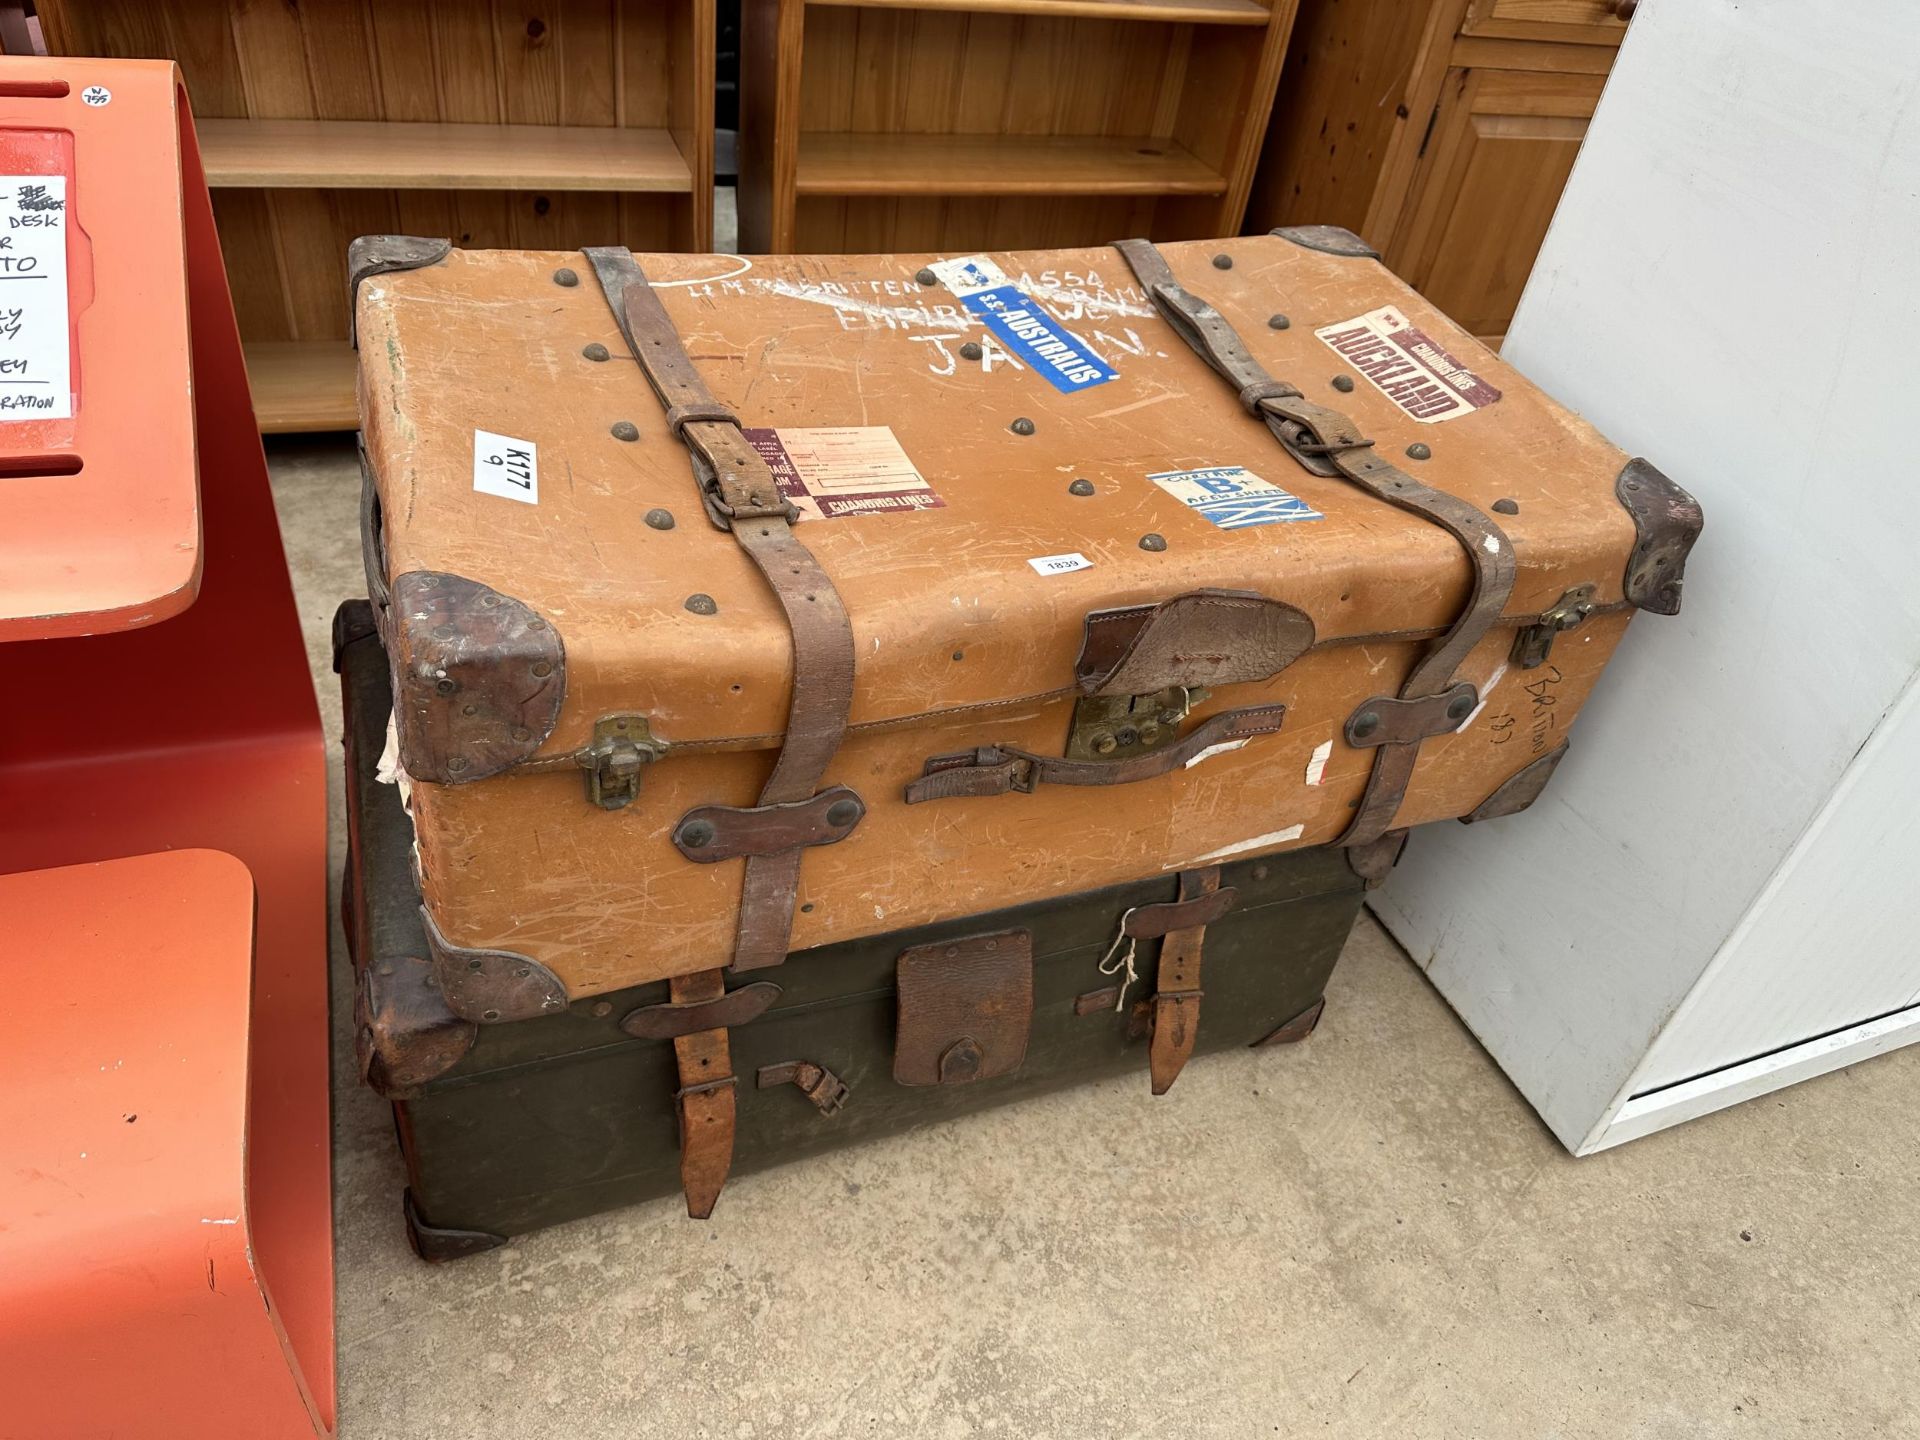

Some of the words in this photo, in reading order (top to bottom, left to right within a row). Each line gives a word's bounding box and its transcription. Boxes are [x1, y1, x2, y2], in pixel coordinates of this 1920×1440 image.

[9, 214, 58, 228] DESK
[996, 309, 1103, 385] AUSTRALIS
[1322, 326, 1460, 419] AUCKLAND
[506, 447, 531, 490] K177
[1193, 477, 1244, 495] B
[827, 496, 900, 512] CHANDRIS
[896, 493, 935, 507] LINES
[1047, 560, 1080, 570] 1839
